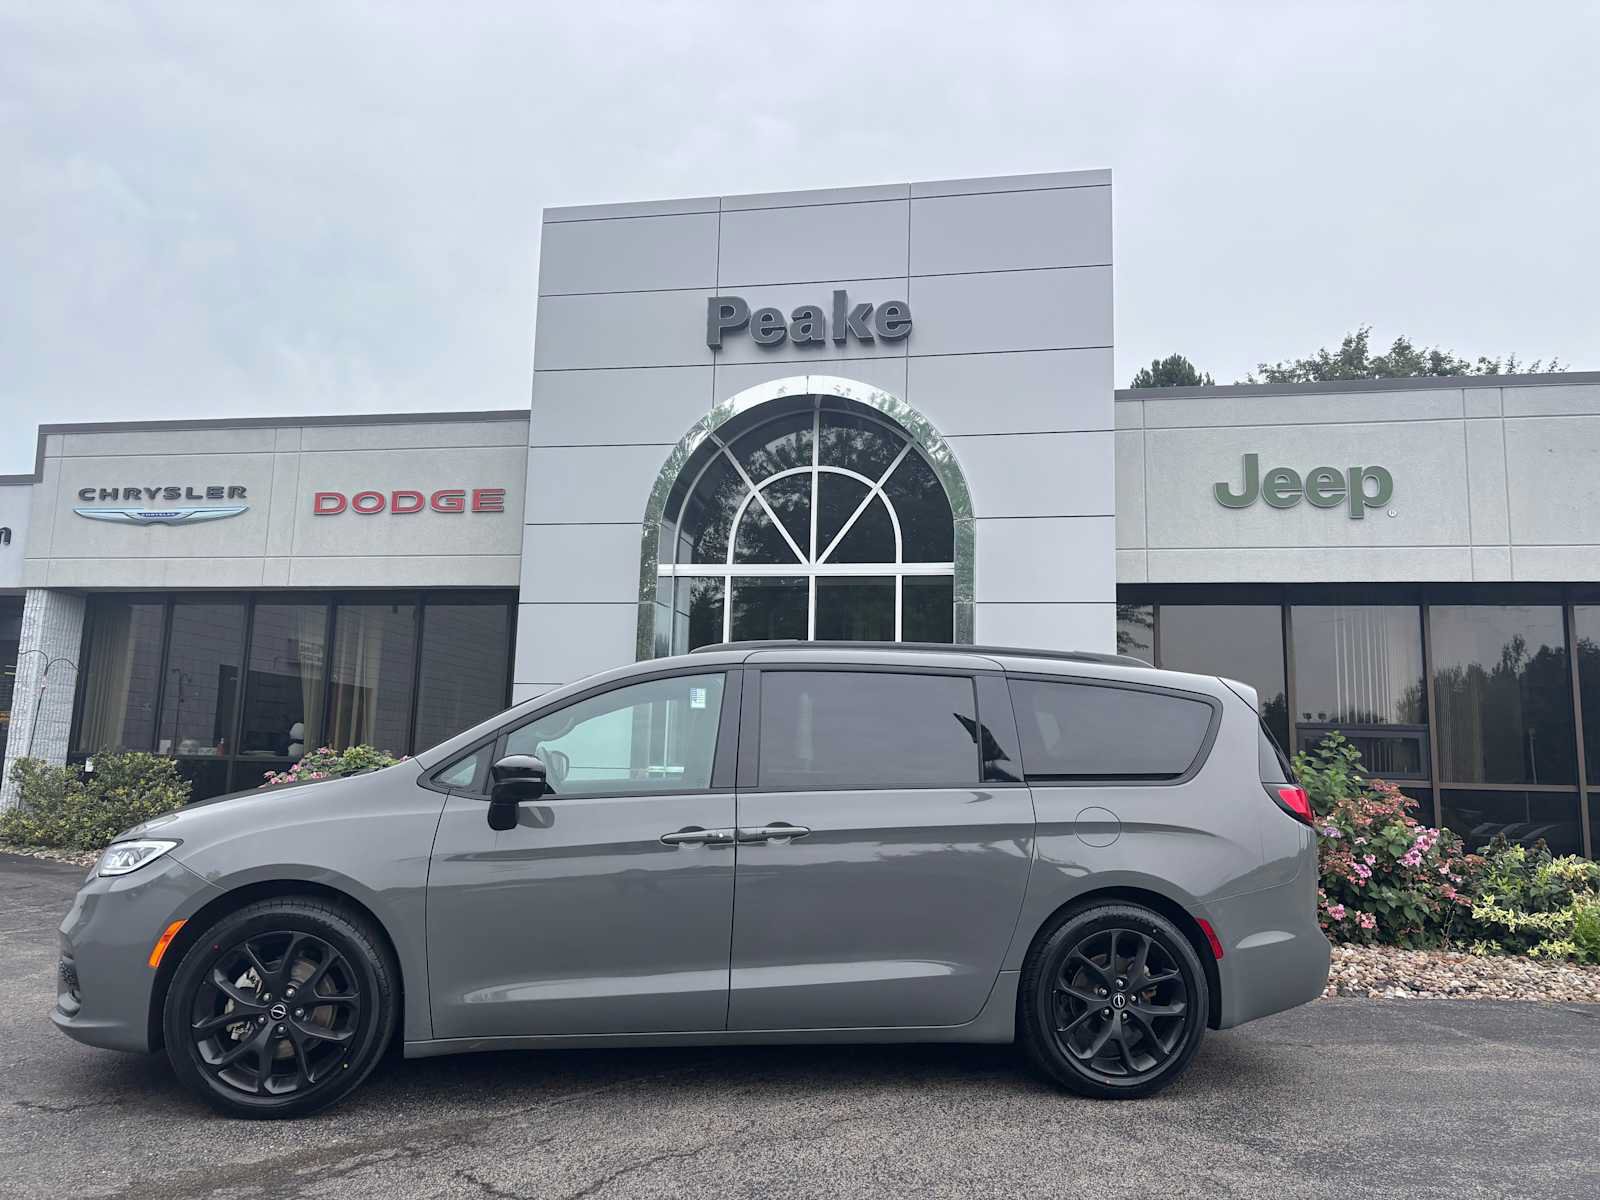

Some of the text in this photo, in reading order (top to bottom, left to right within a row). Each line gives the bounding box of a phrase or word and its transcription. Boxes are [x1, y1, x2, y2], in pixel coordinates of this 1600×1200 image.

[706, 289, 913, 350] Peake
[78, 485, 248, 501] CHRYSLER
[313, 488, 506, 515] DODGE
[1213, 453, 1394, 519] Jeep
